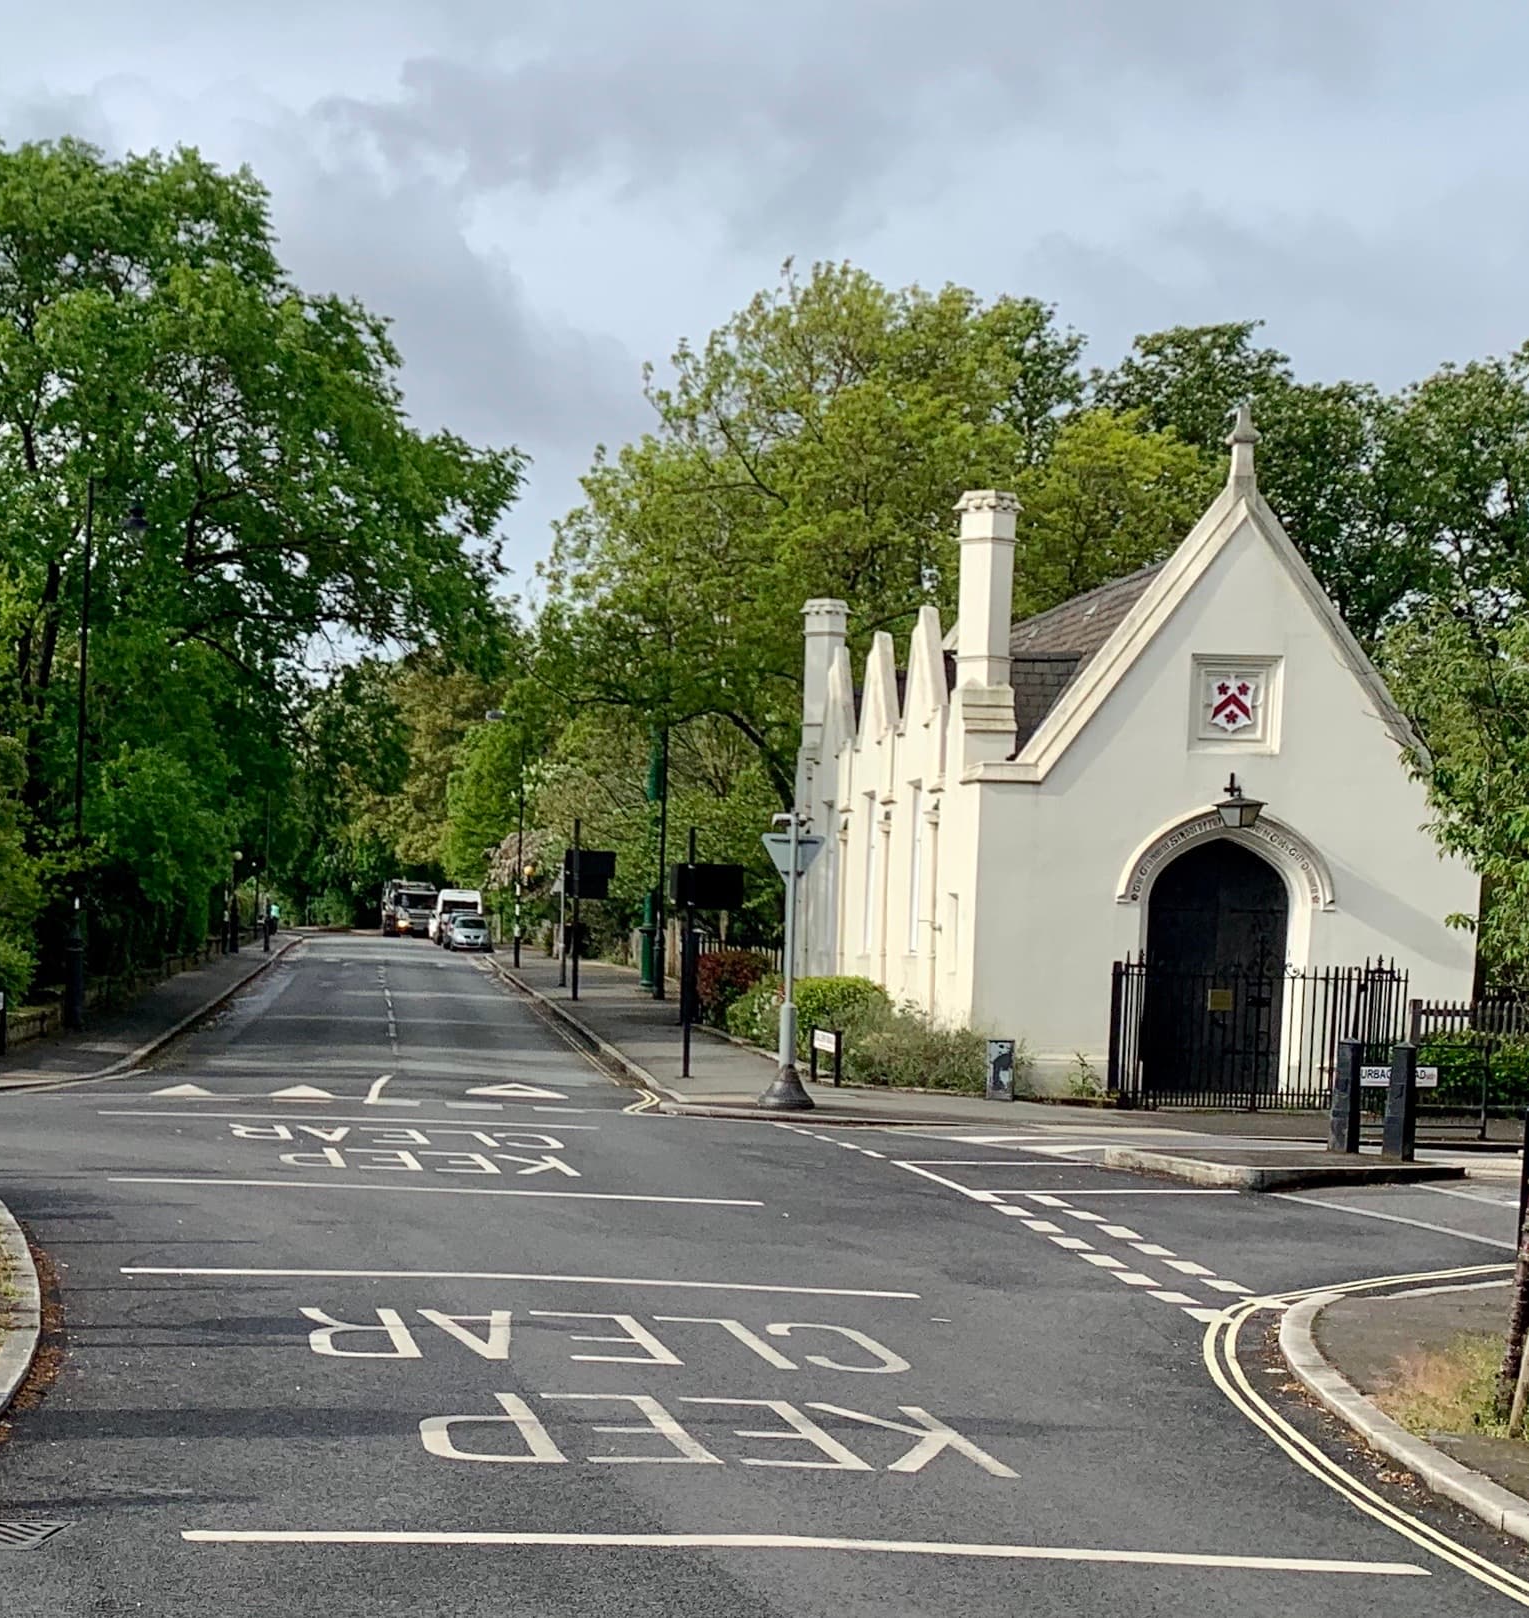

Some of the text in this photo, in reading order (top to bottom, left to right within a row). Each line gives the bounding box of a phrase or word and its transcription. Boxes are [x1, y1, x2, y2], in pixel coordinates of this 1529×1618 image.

[1361, 1069, 1392, 1079] URBAG
[229, 1123, 566, 1149] CLEAR
[279, 1147, 582, 1177] KEEP
[298, 1307, 911, 1374] CLEAR
[419, 1392, 1022, 1478] KEEP
